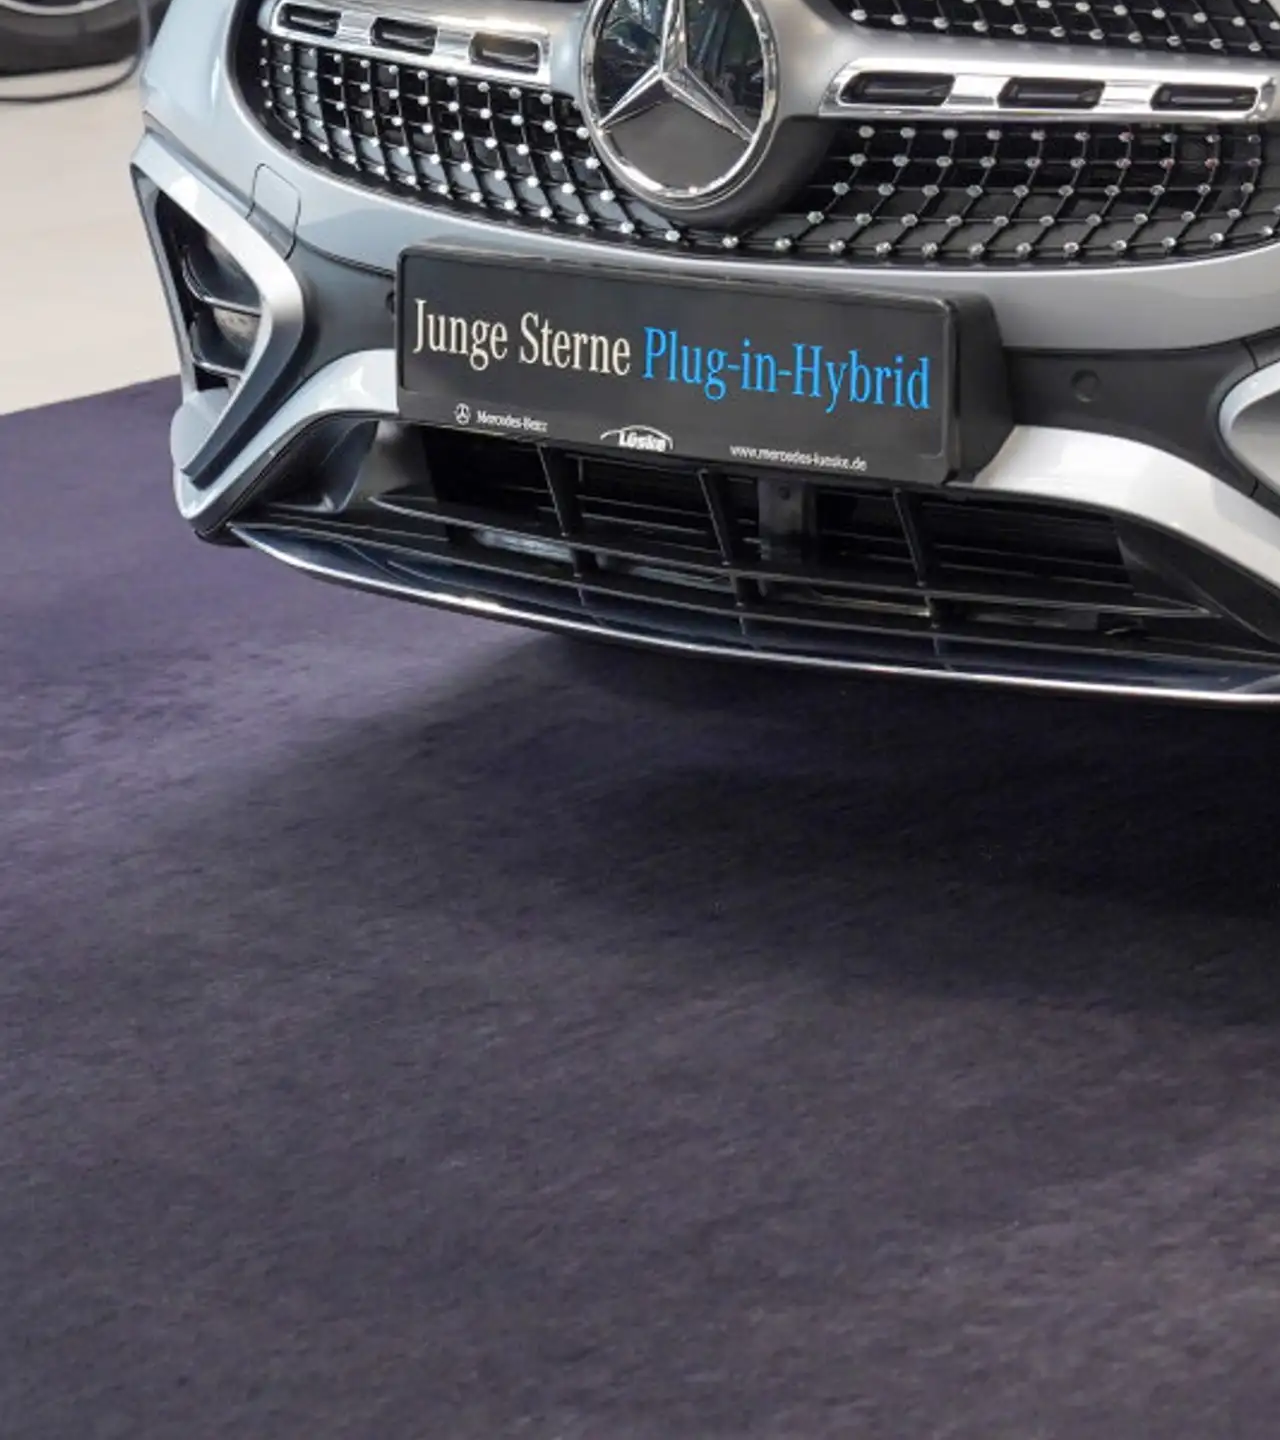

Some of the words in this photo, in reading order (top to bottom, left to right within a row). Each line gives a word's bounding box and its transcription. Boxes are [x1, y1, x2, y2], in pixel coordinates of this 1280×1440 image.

[412, 298, 508, 372] Junge
[518, 311, 632, 376] Sterne
[642, 325, 932, 414] Plug-in-Hybrid
